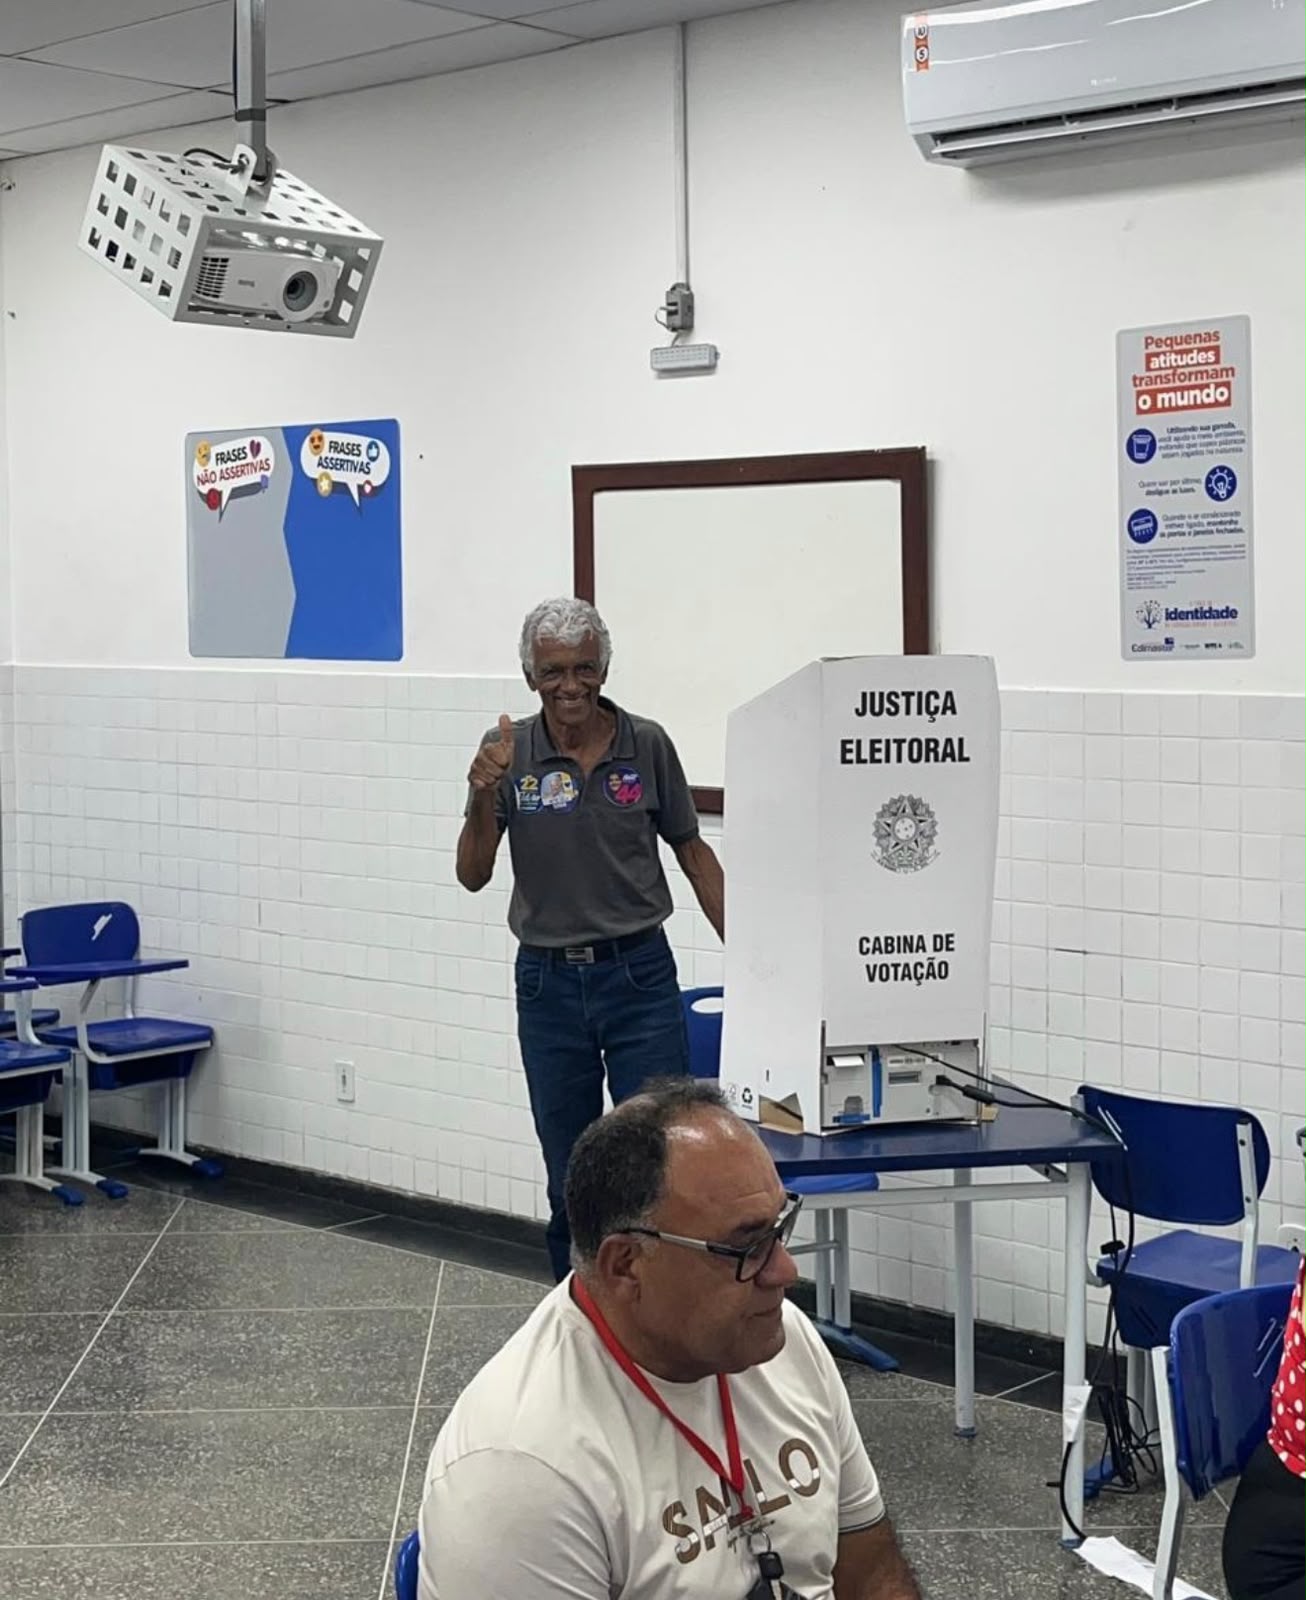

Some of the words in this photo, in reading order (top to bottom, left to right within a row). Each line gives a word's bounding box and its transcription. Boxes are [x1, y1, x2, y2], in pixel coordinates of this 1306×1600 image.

[1144, 330, 1220, 350] Pequenas
[1150, 350, 1216, 369] atitudes
[1132, 366, 1235, 388] transformam
[1138, 394, 1151, 410] o
[1157, 384, 1229, 408] mundo
[215, 446, 248, 466] FRASES
[328, 440, 362, 456] FRASES
[196, 468, 216, 486] NÃO
[219, 458, 271, 482] ASSERTIVAS
[317, 456, 371, 475] ASSERTIVAS
[1165, 606, 1238, 620] identidade
[854, 690, 957, 723] JUSTIÇA
[840, 737, 970, 764] ELEITORAL
[858, 934, 926, 956] CABINA
[932, 933, 955, 952] DE
[866, 957, 950, 986] VOTAÇÃO
